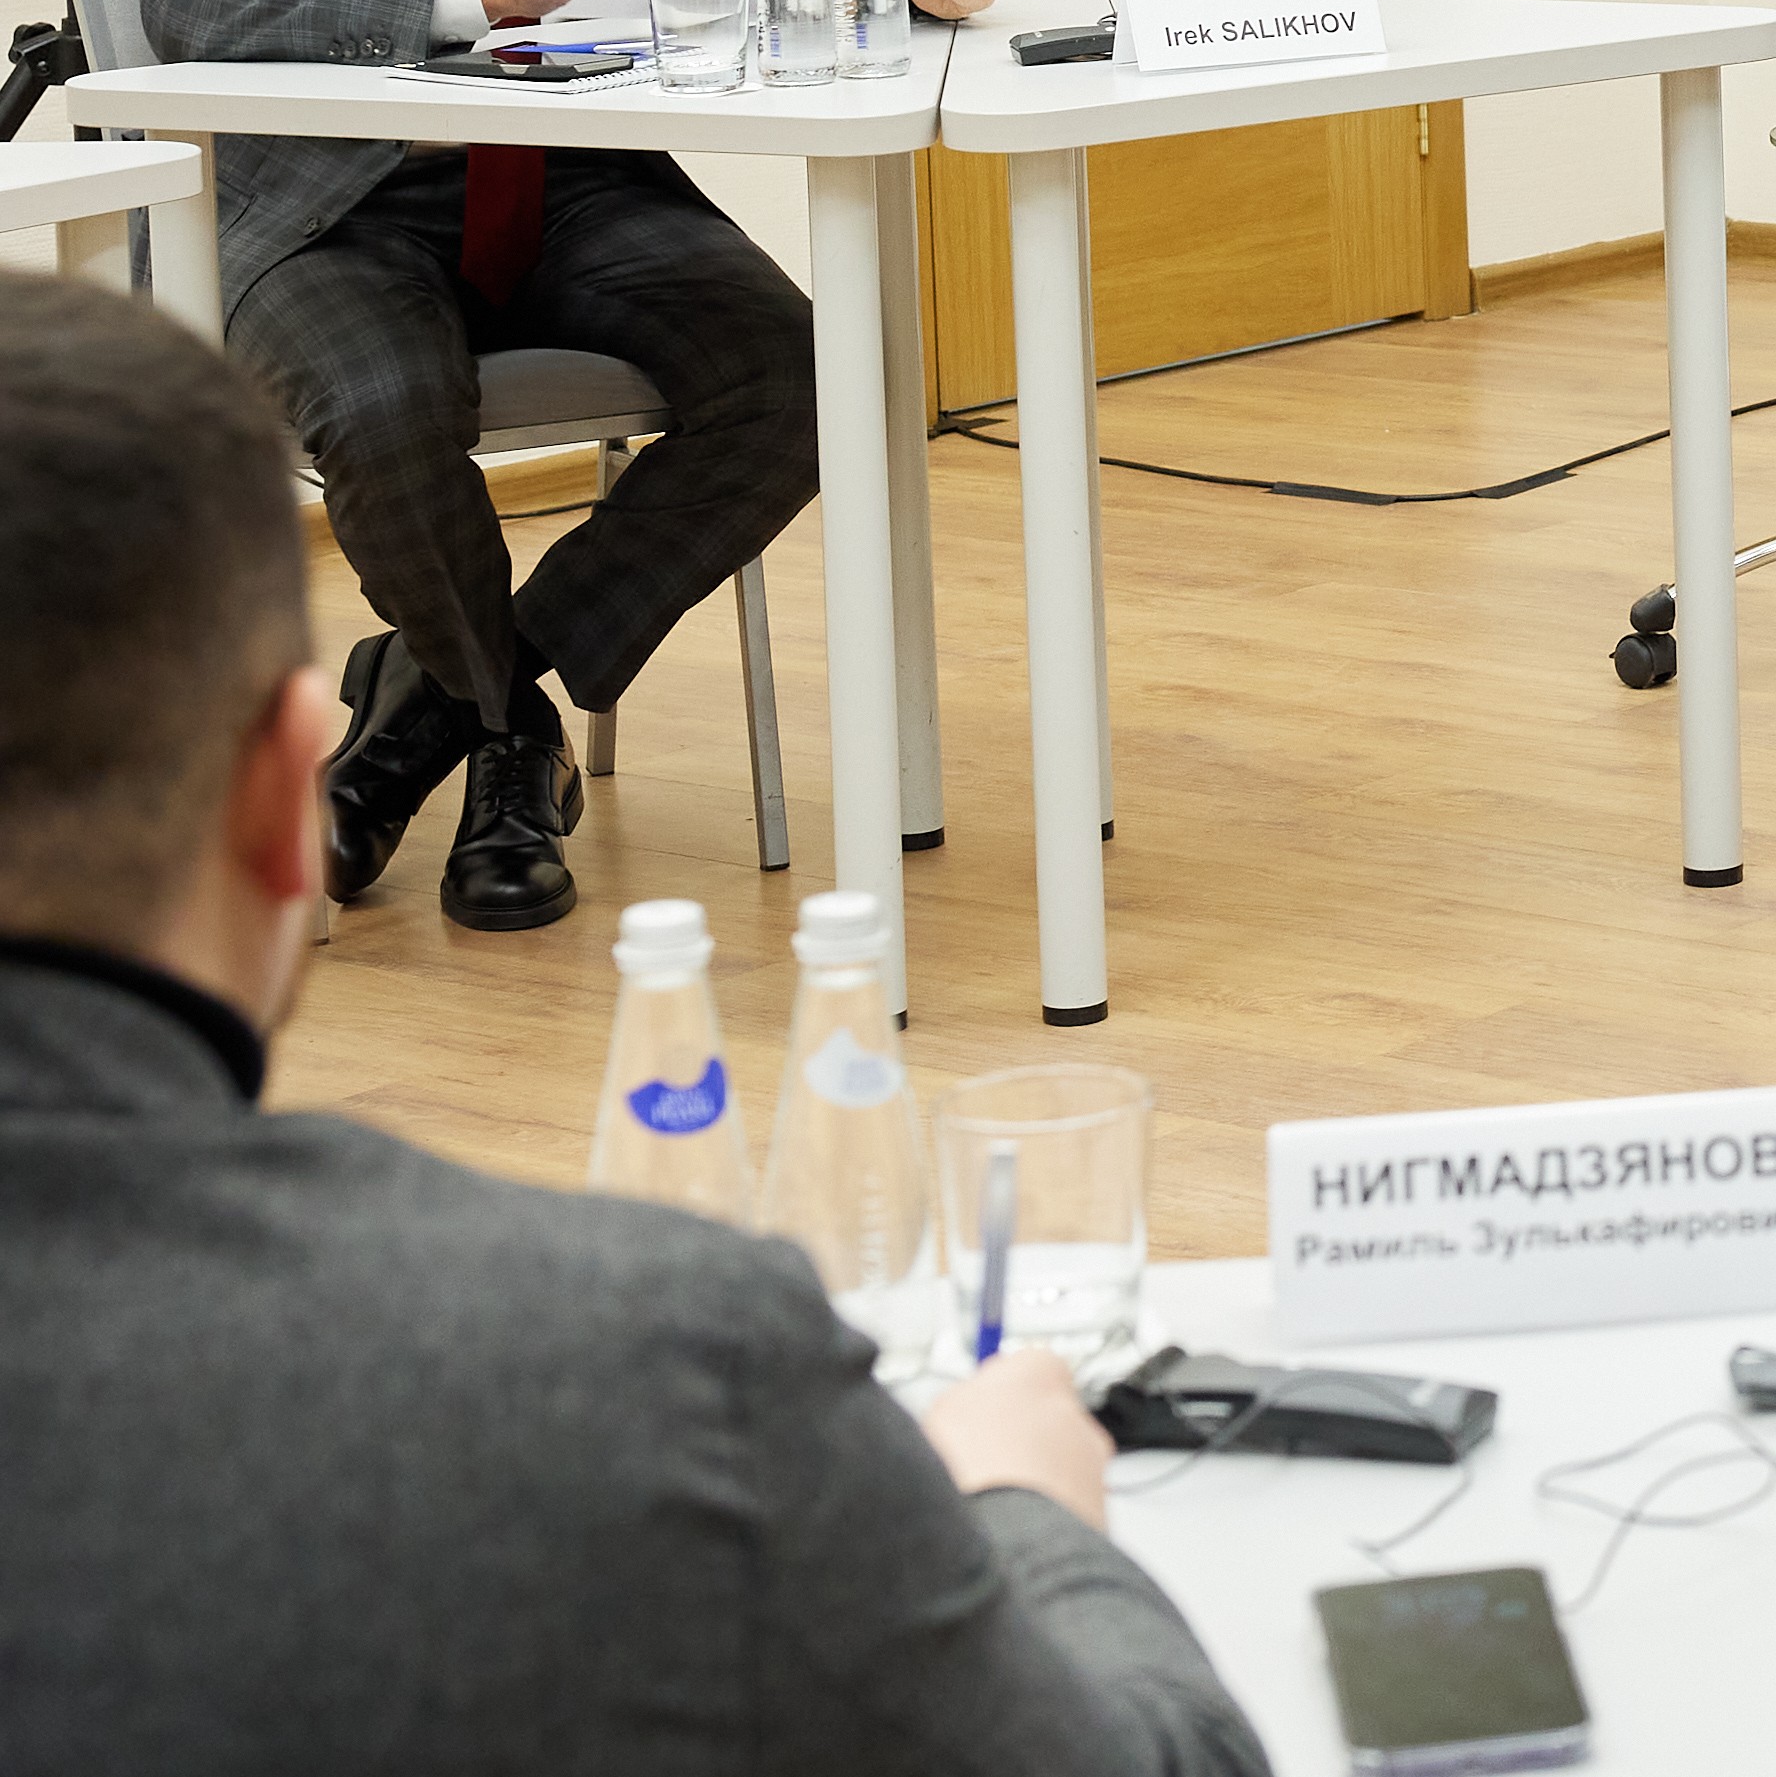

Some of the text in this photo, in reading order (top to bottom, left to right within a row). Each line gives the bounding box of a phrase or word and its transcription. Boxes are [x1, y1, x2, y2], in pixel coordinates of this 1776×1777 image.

[1166, 11, 1356, 47] Irek SALIKHOV
[1296, 1229, 1459, 1267] Рамиль
